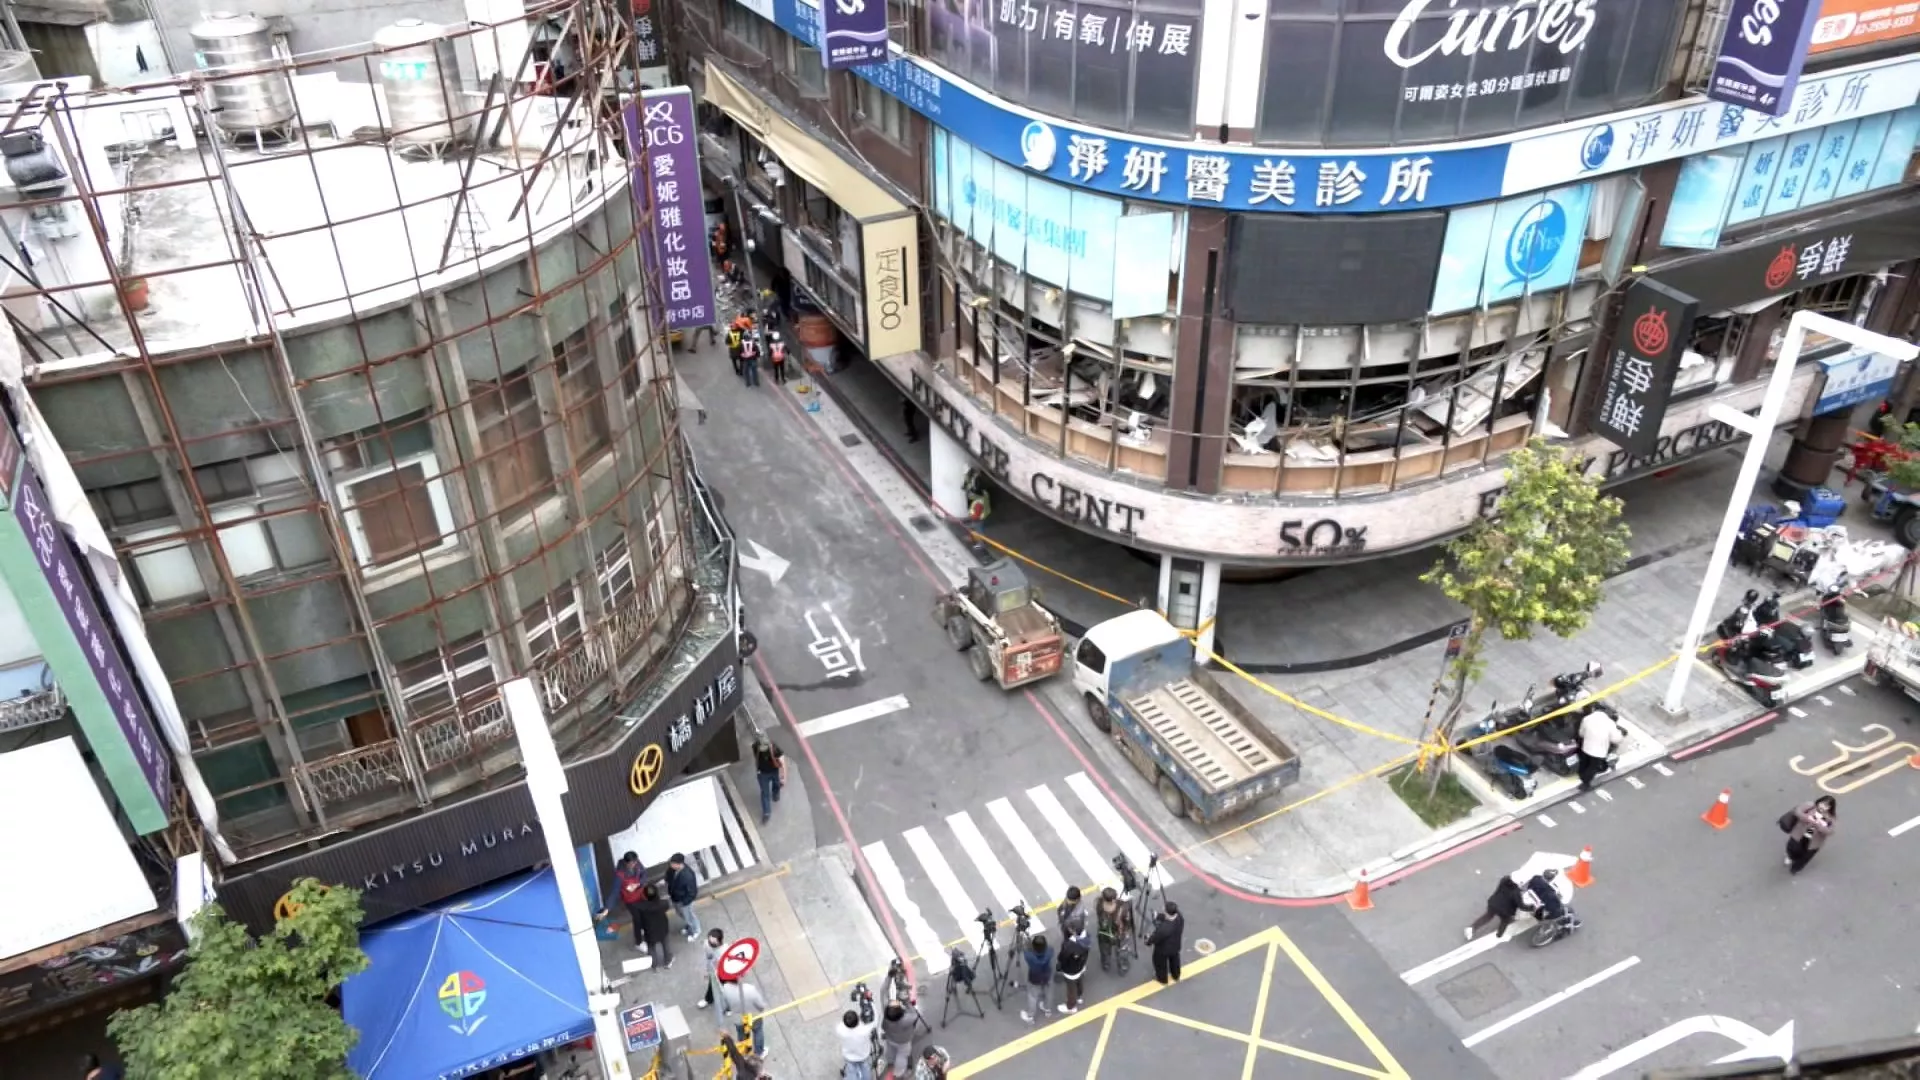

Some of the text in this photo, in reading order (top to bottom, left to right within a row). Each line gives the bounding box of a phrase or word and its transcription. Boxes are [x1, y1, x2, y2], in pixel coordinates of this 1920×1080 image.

[1384, 0, 1597, 68] Curves
[1067, 134, 1434, 207] 淨妍醫美診所
[653, 153, 693, 301] 愛妮雅化妝品
[1796, 233, 1854, 280] 爭鮮
[875, 248, 902, 321] 定食8
[1600, 381, 1617, 422] EXPRESS
[1608, 356, 1654, 438] 爭鮮
[1031, 472, 1145, 538] CENT
[669, 665, 737, 753] 橘村屋
[1789, 723, 1920, 794] 30
[364, 816, 541, 890] KITSU MURA
